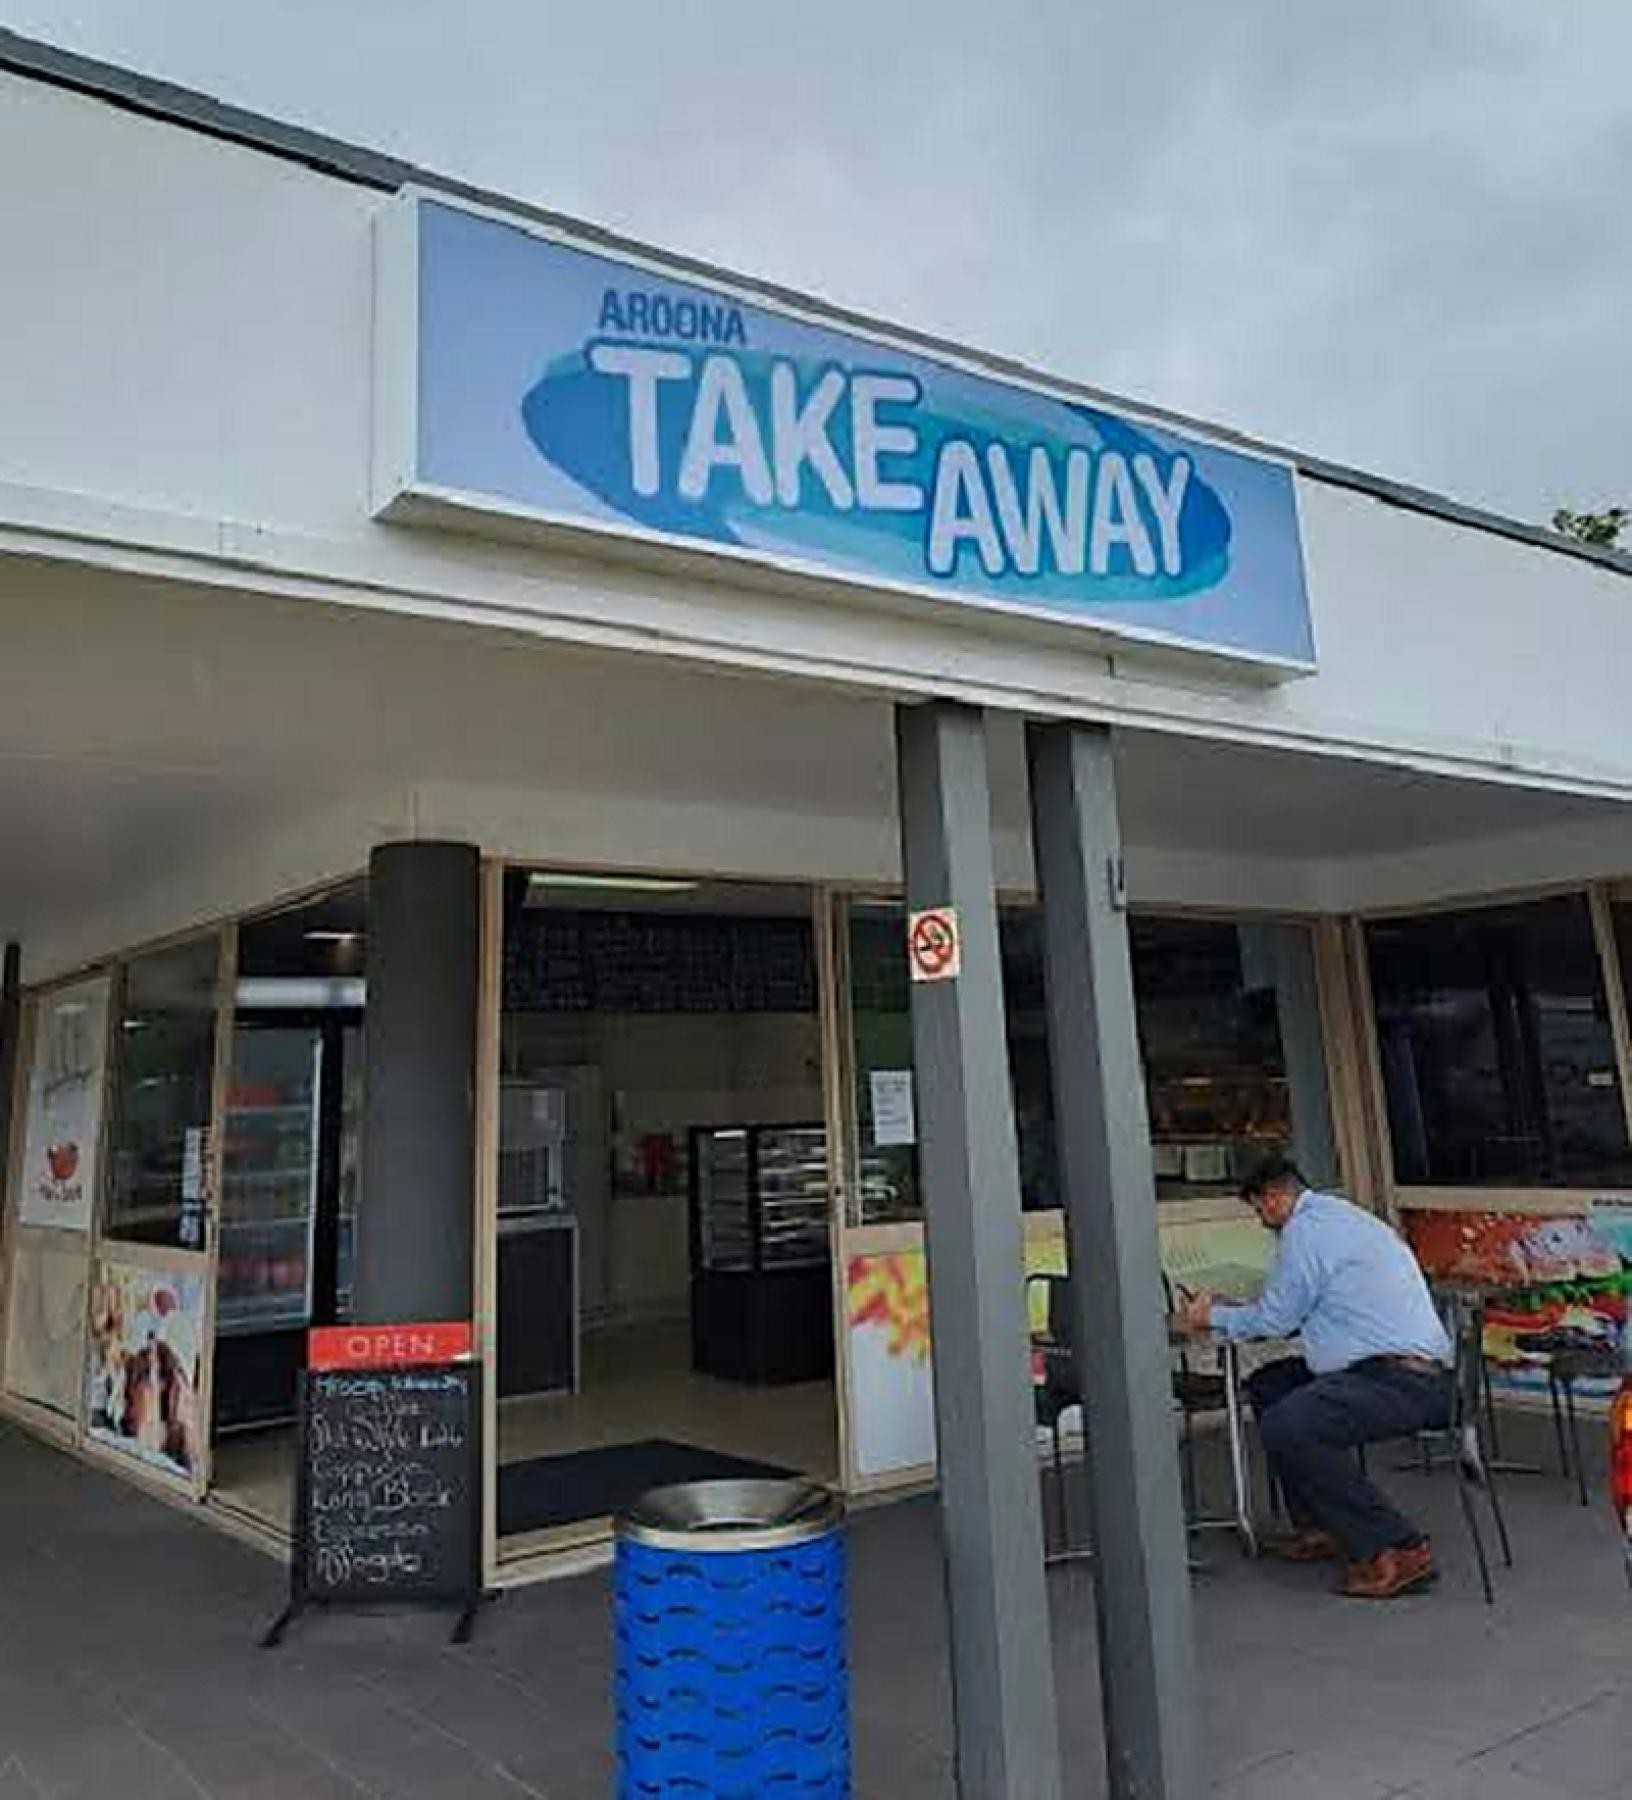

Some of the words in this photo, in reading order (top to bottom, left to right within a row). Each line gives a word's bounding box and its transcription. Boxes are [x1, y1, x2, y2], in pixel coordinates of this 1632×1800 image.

[600, 288, 747, 345] AROONA
[588, 343, 924, 511] TAKE
[929, 441, 1193, 576] AWAY
[347, 1334, 435, 1358] OPEN
